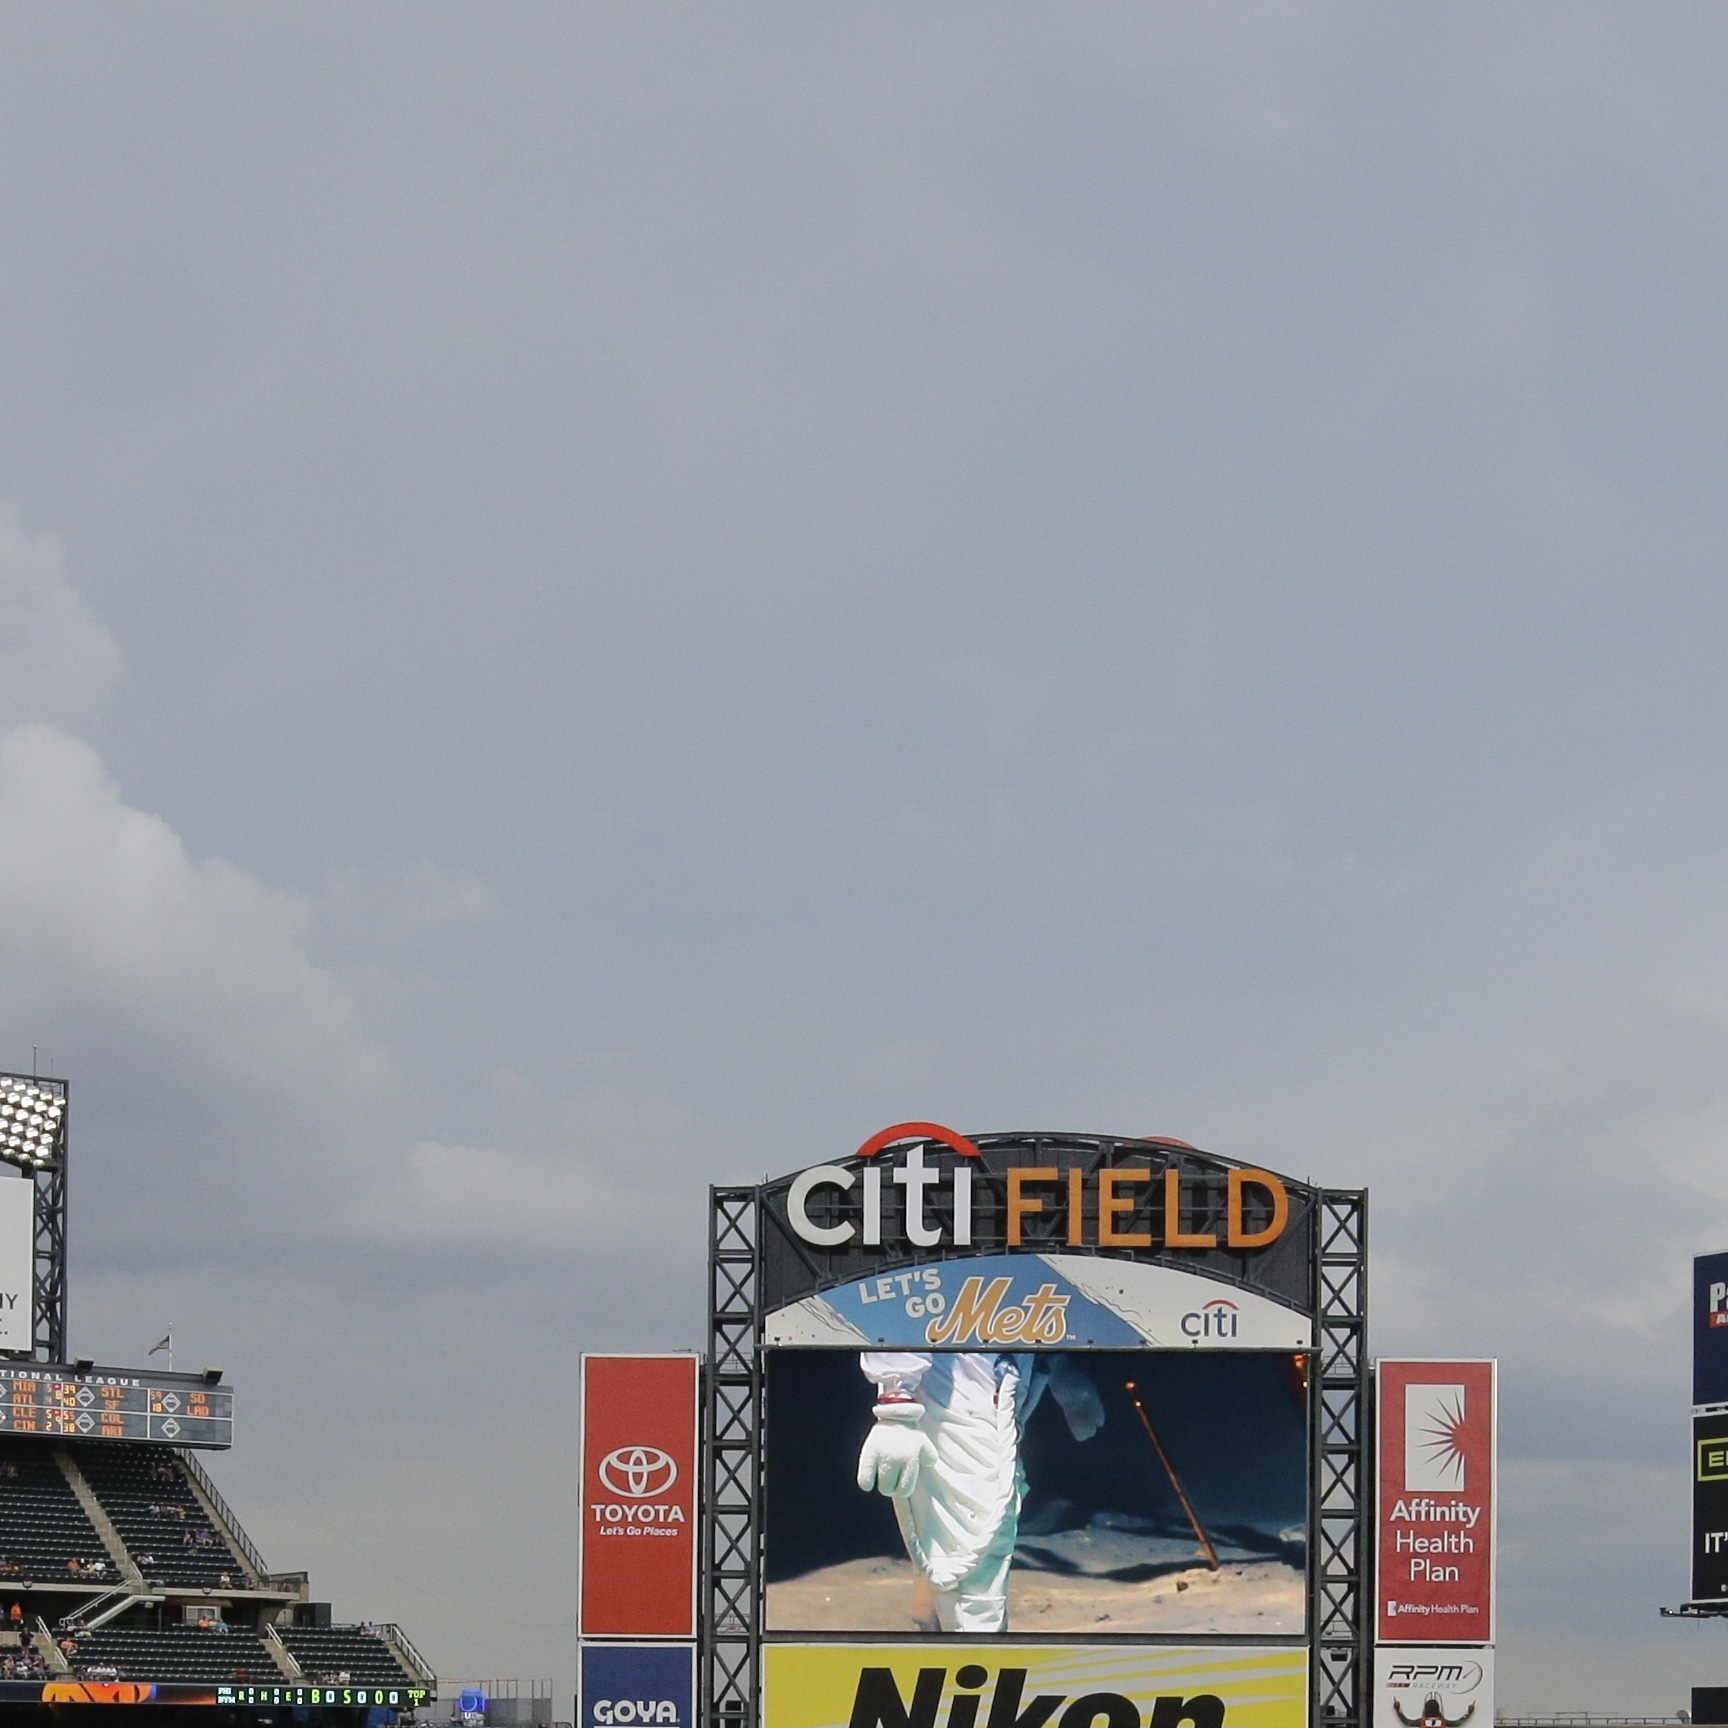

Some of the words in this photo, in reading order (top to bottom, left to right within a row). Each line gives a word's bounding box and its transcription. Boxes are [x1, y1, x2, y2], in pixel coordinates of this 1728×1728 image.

[786, 1144, 971, 1247] citi
[1007, 1166, 1289, 1248] FIELD
[859, 1268, 941, 1304] LET'S
[905, 1293, 945, 1318] GO
[925, 1276, 1071, 1344] Mets
[74, 1374, 141, 1387] LEAGUE
[591, 1504, 685, 1523] TOYOTA
[1390, 1499, 1481, 1528] Affinity
[600, 1526, 624, 1536] Let's
[626, 1526, 641, 1536] Go
[643, 1526, 678, 1537] Places
[1396, 1530, 1473, 1553] Health
[1411, 1559, 1459, 1582] Plan
[1389, 1665, 1463, 1680] RPM
[593, 1700, 678, 1725] GOYA
